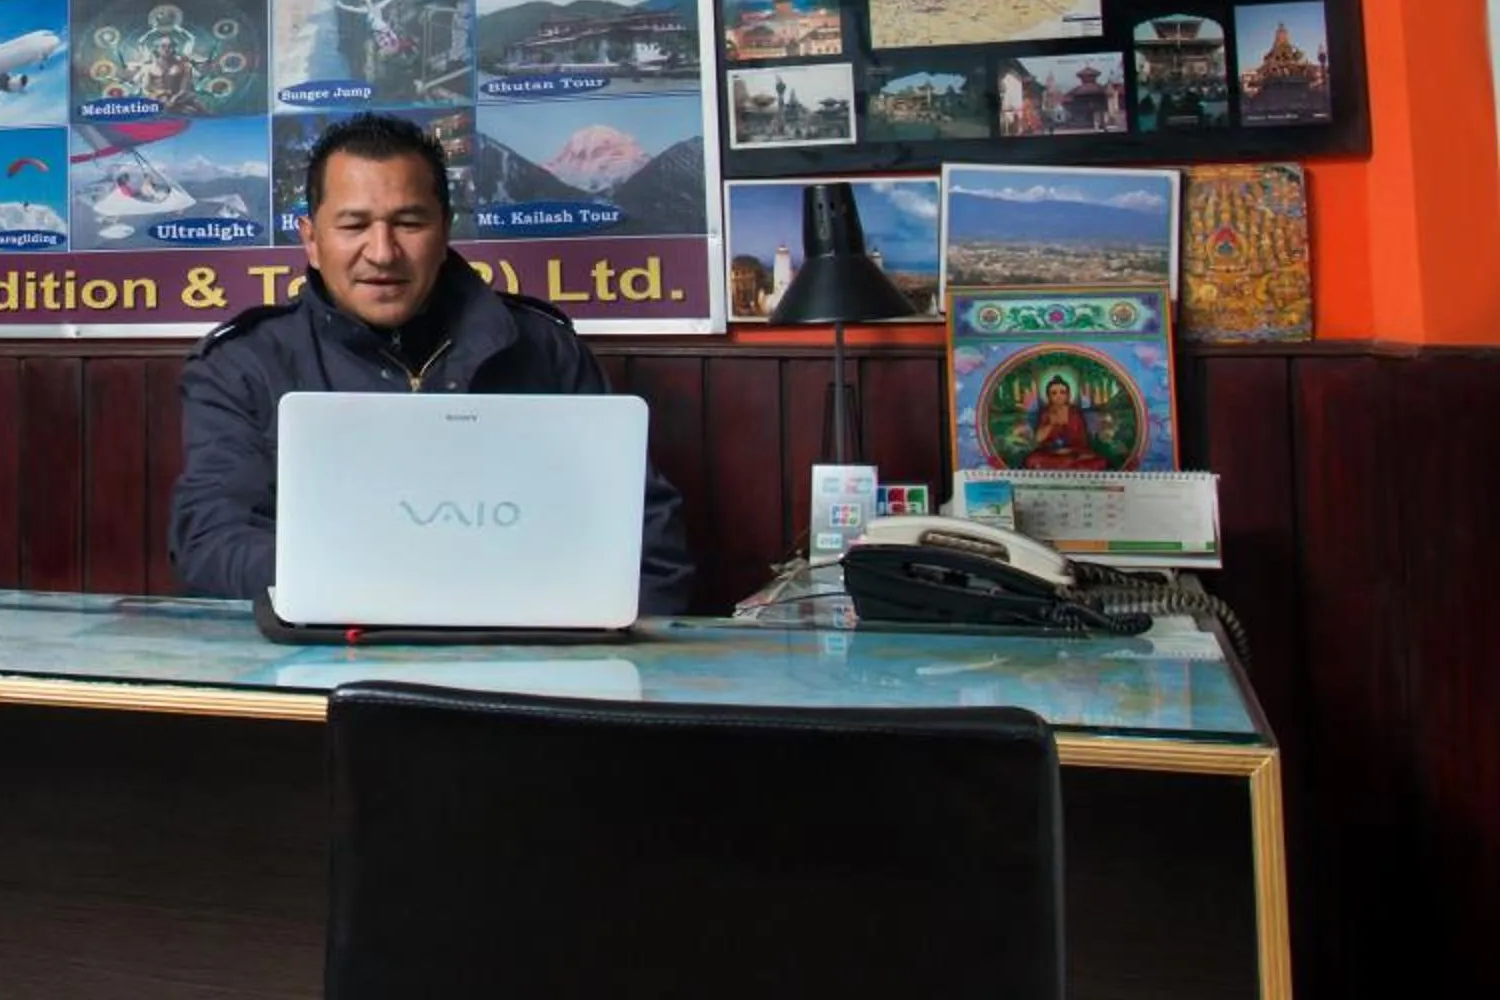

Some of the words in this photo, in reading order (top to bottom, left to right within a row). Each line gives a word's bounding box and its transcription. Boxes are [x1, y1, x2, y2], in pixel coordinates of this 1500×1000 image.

[281, 88, 330, 102] Bungee
[332, 85, 372, 101] Jump
[487, 79, 554, 93] Bhutan
[558, 77, 604, 89] Tour
[81, 101, 160, 117] Meditation
[477, 213, 506, 226] Mt.
[511, 210, 573, 225] Kailash
[578, 208, 621, 222] Tour
[156, 223, 255, 241] Ultralight
[180, 266, 229, 309] &
[547, 255, 686, 303] Ltd.
[399, 500, 521, 526] VAIO
